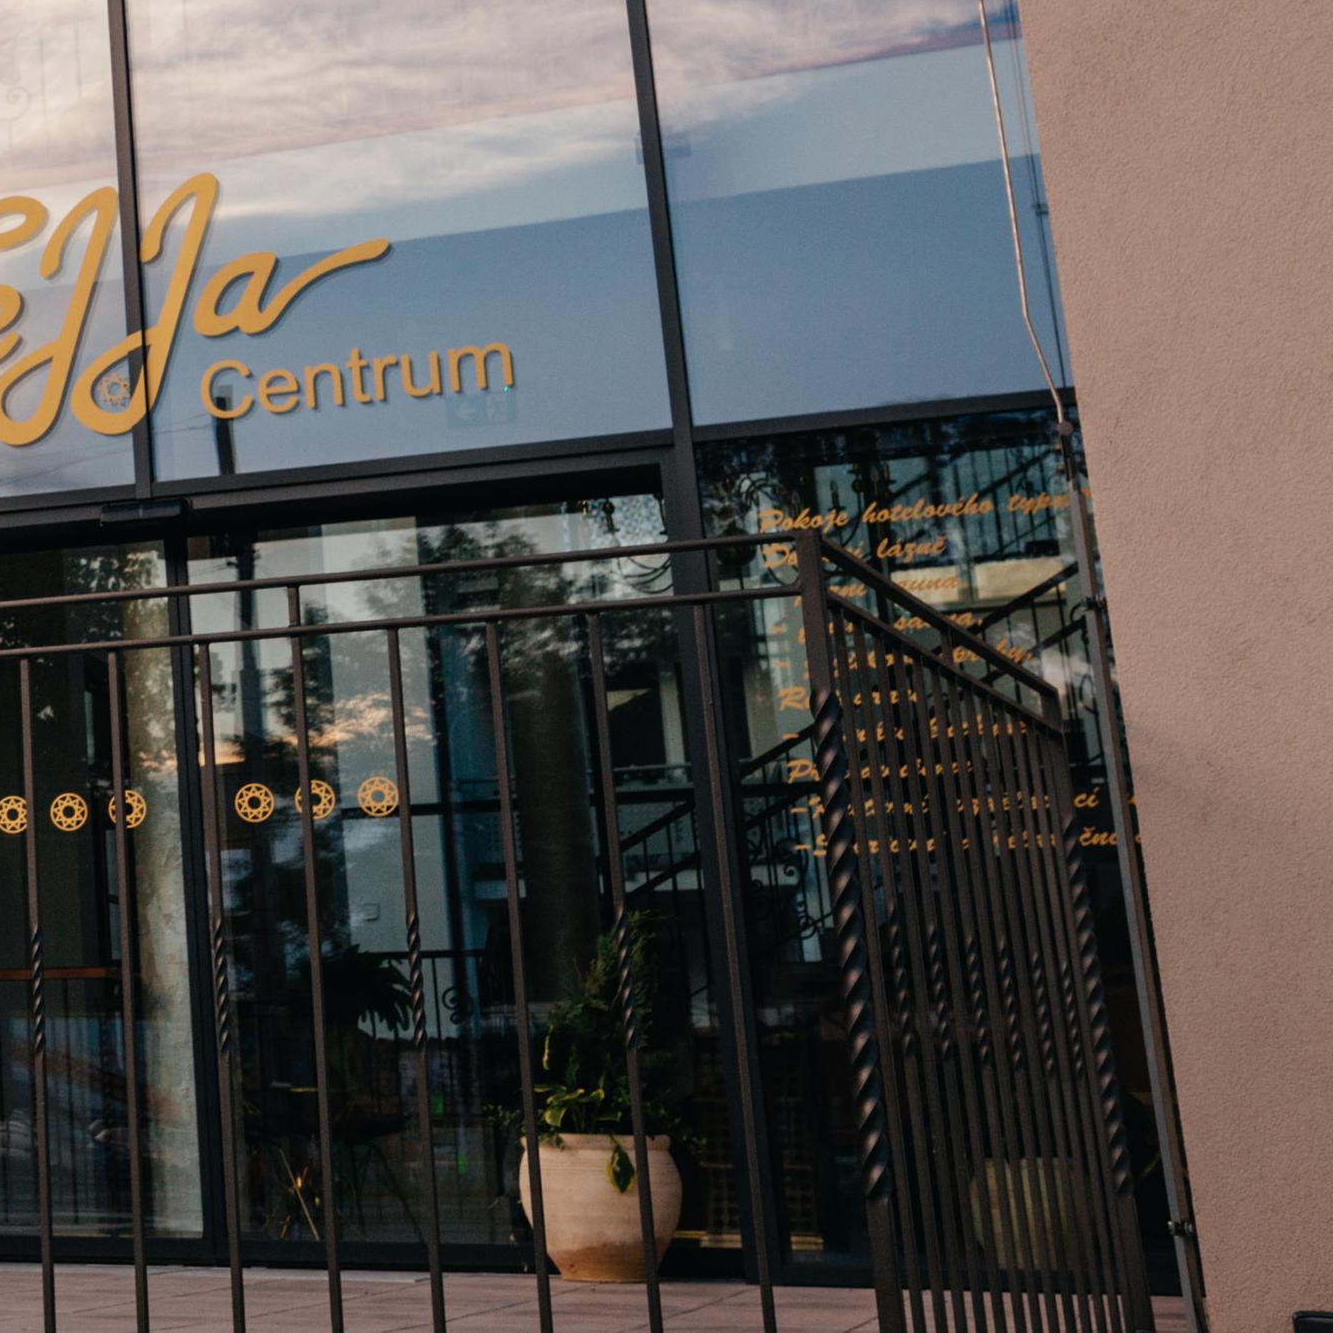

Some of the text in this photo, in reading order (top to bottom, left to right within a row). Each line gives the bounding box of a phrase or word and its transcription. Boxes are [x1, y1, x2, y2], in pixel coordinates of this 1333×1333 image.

[201, 342, 516, 420] Centrum
[760, 508, 849, 535] Pokoje
[862, 493, 994, 523] hotelového
[877, 535, 946, 564] lázně
